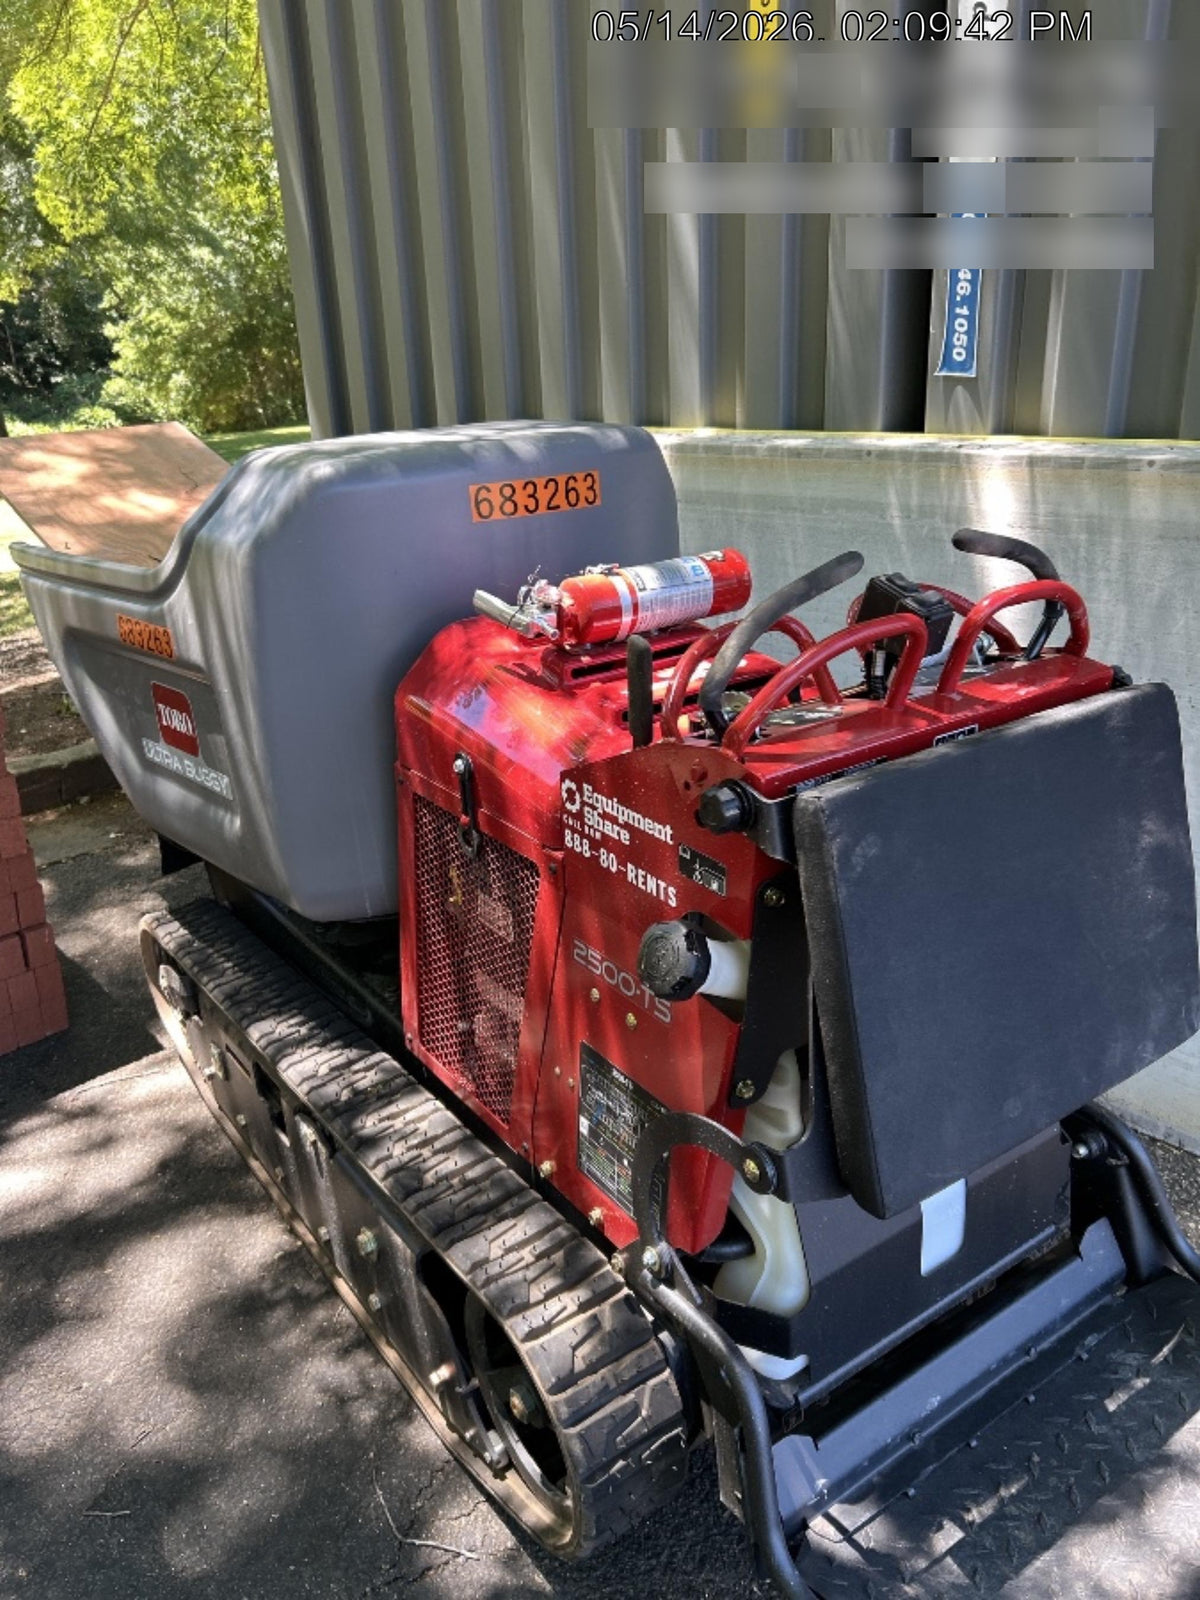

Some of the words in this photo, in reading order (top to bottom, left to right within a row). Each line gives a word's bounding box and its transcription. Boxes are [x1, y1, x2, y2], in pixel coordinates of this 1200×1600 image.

[473, 472, 598, 520] 683263
[157, 703, 198, 737] TORO
[582, 783, 674, 845] Equipment
[583, 805, 631, 845] Share
[564, 829, 677, 907] 888-80-RENTS
